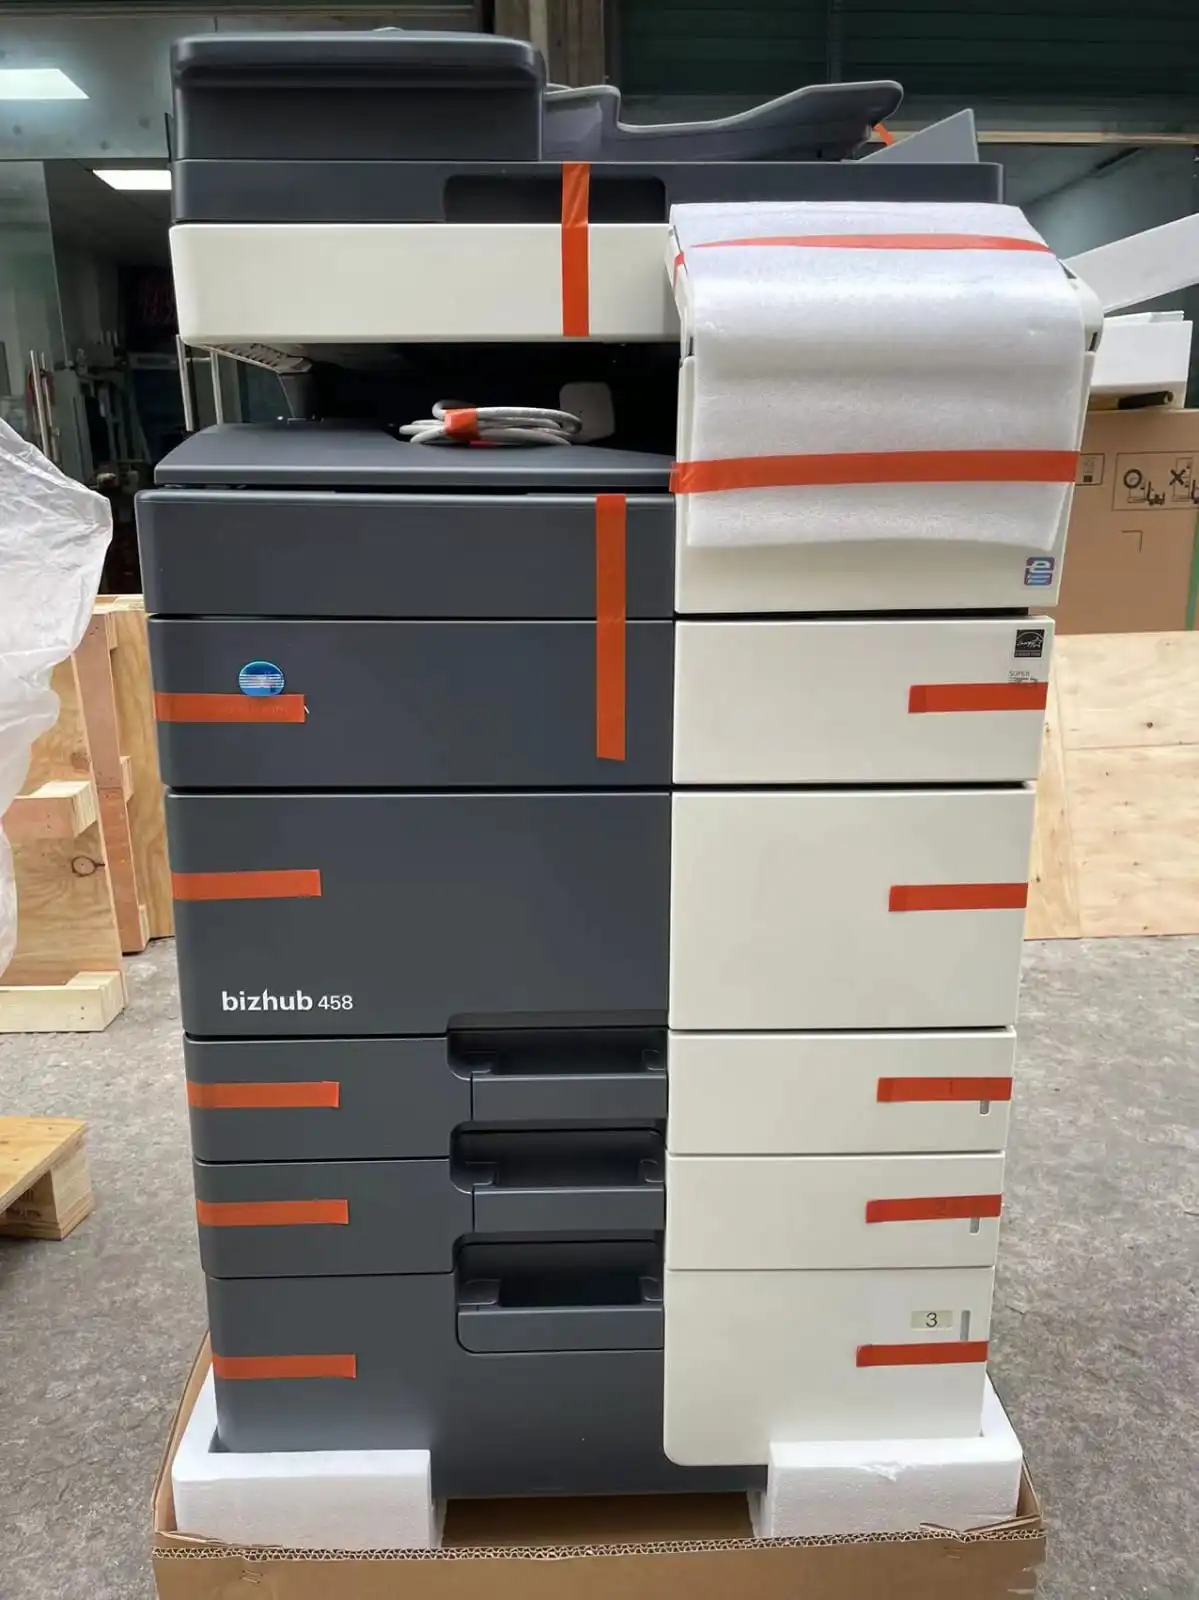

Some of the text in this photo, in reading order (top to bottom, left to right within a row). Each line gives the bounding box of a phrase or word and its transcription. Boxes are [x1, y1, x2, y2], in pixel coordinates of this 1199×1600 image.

[221, 988, 354, 1011] bizhub 458
[925, 1311, 938, 1328] 3
